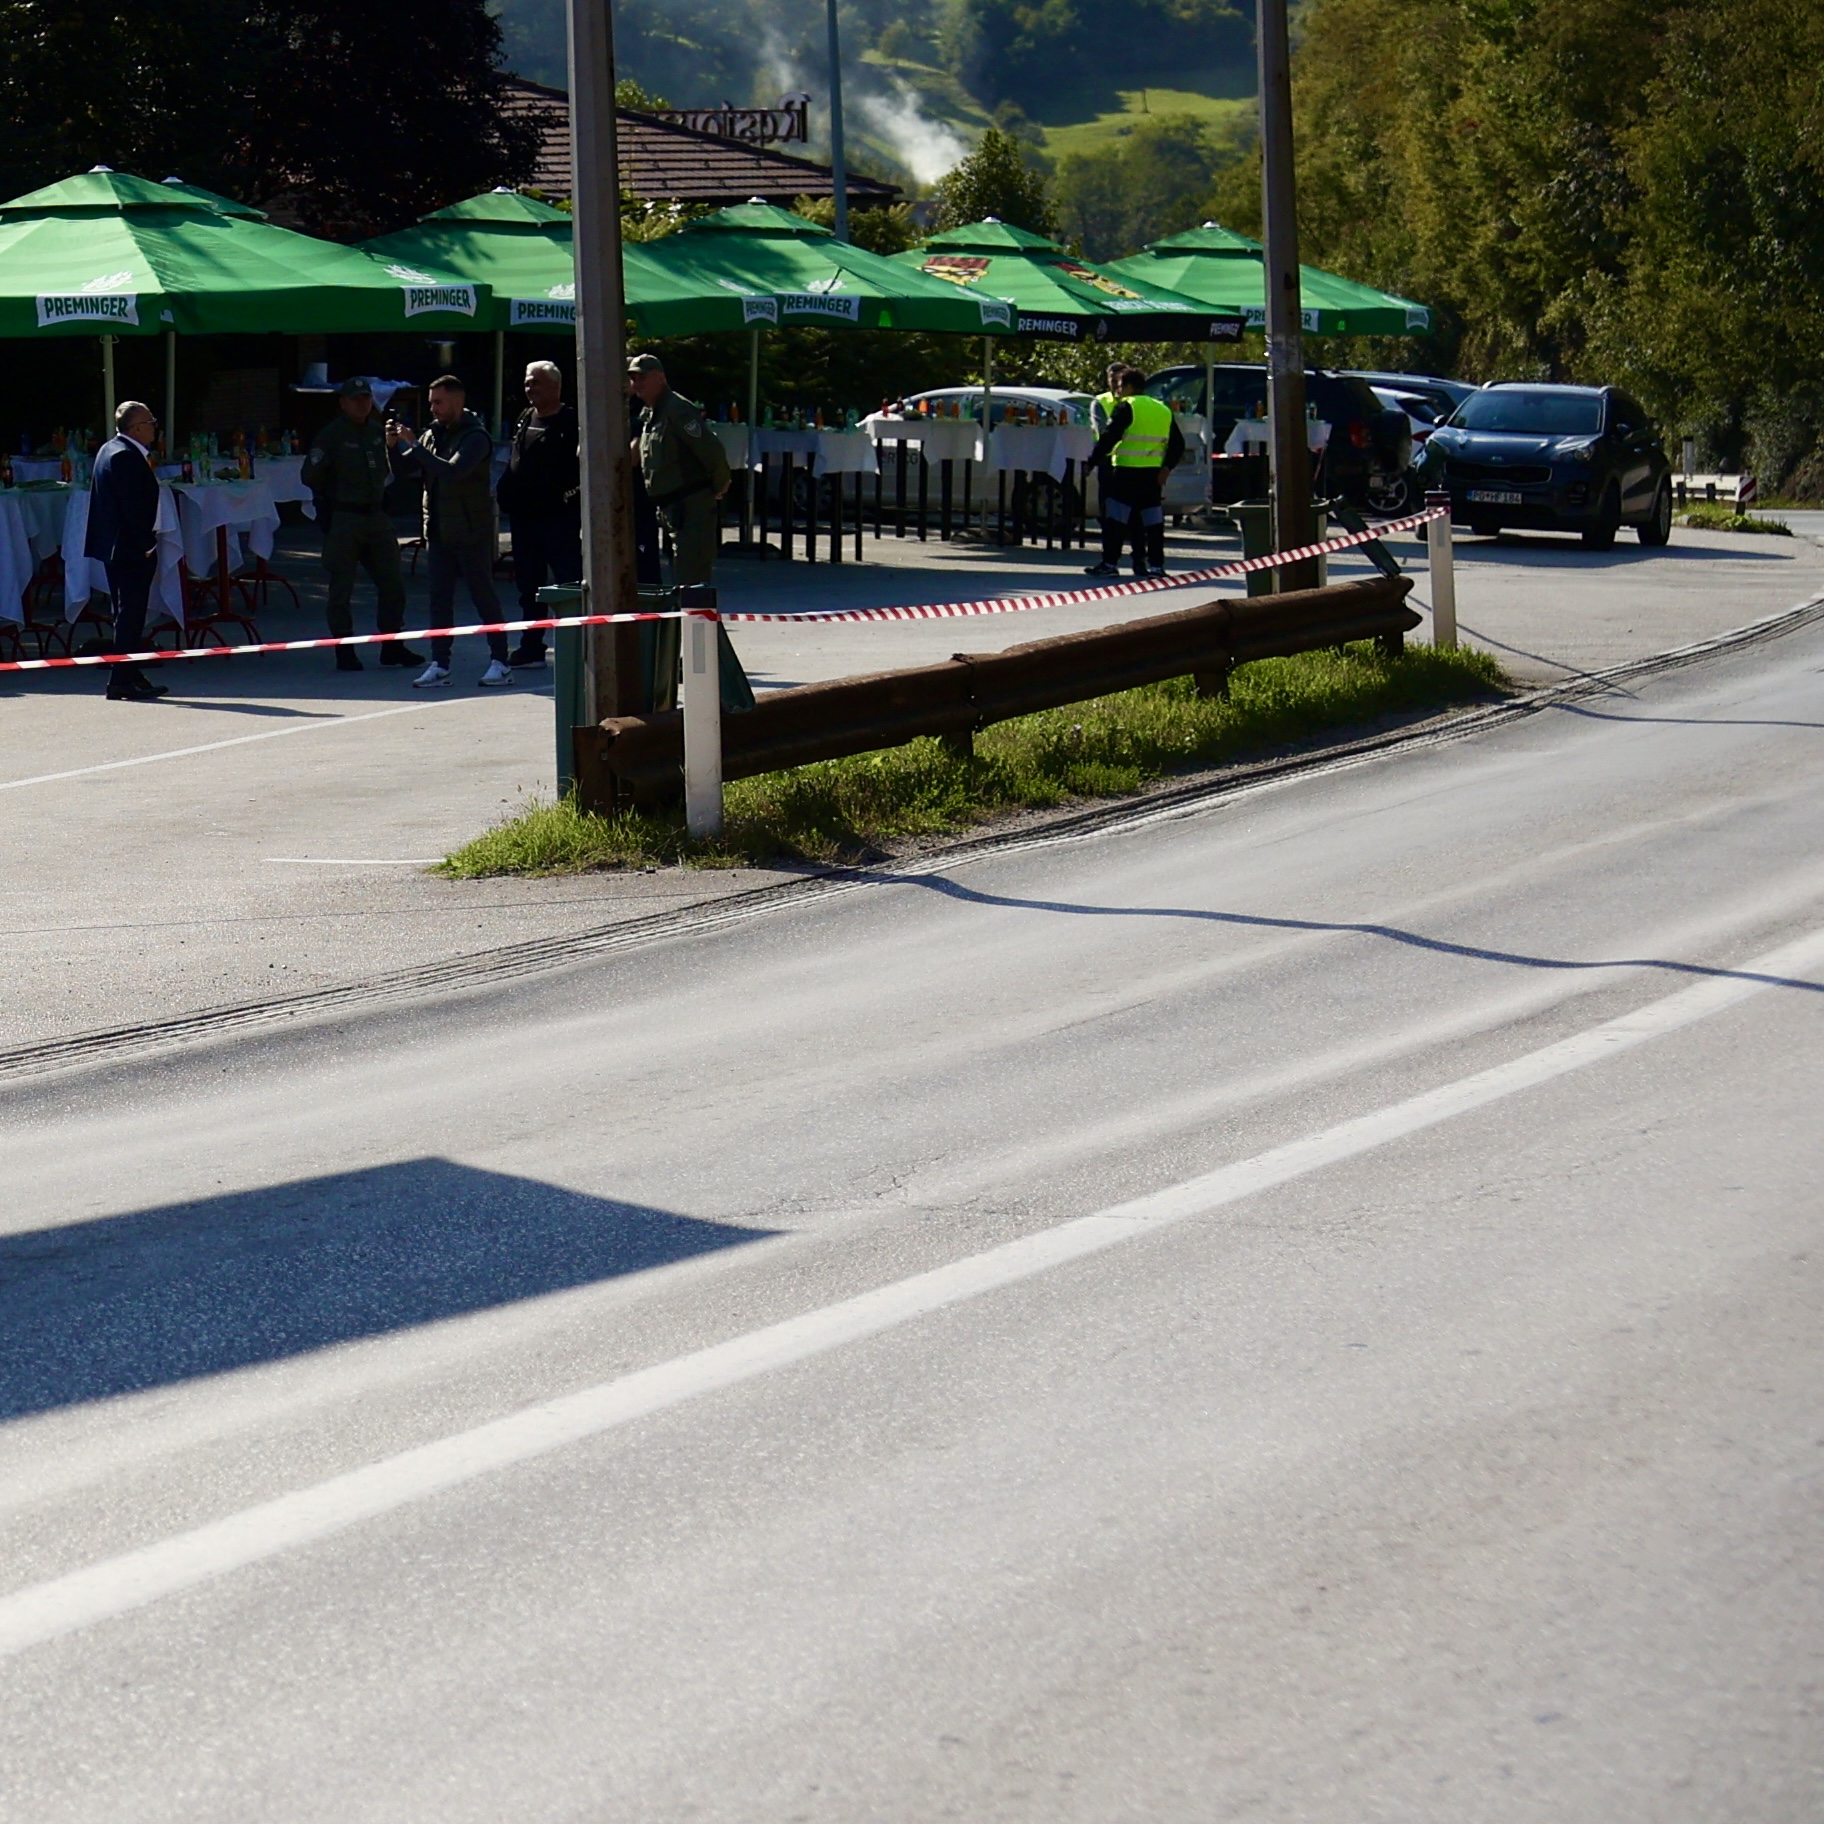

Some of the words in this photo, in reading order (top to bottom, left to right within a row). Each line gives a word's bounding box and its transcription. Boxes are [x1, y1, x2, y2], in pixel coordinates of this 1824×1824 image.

[44, 297, 128, 318] PREMINGER
[410, 289, 471, 309] PREMINGER
[787, 295, 852, 314] REMINGER
[518, 302, 576, 320] PREMING
[1018, 318, 1078, 337] REMINGER
